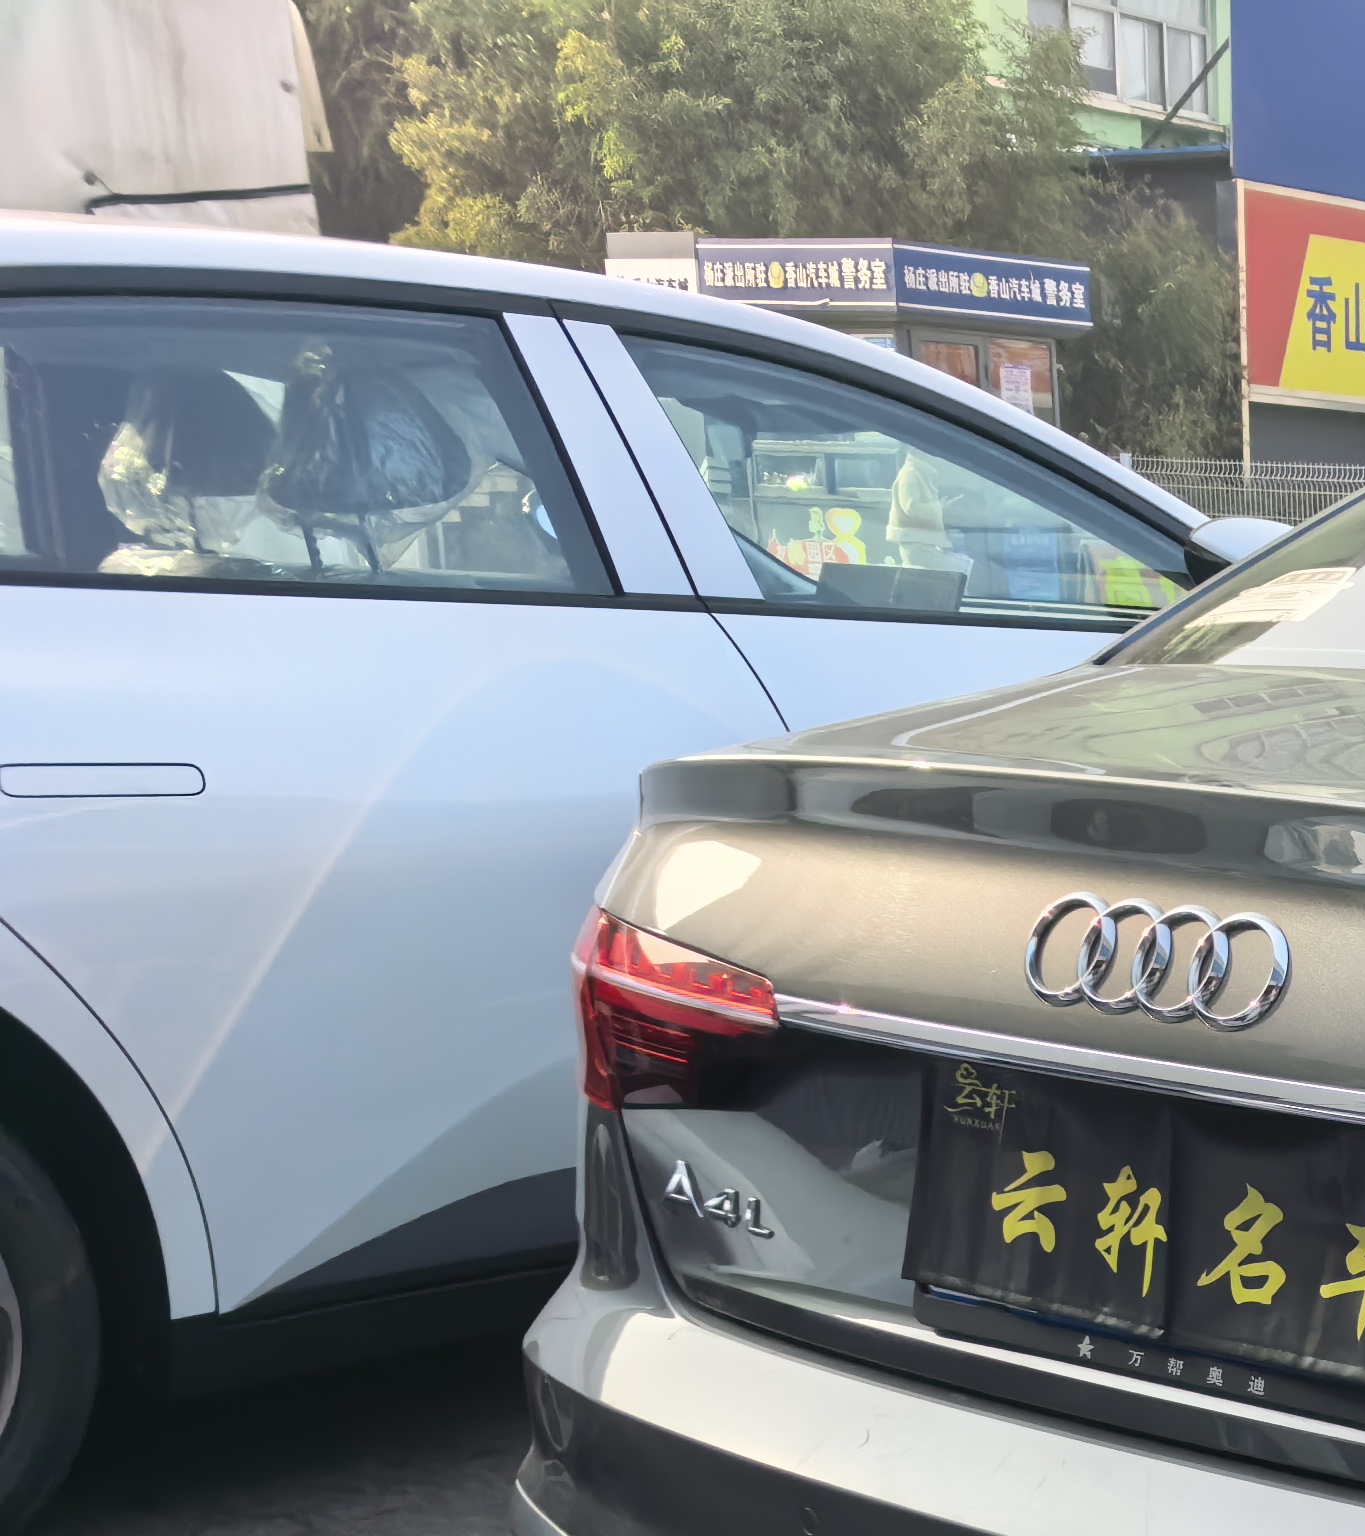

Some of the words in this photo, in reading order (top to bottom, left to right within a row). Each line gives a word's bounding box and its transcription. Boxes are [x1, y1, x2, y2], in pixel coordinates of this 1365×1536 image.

[663, 1159, 775, 1239] A4L
[1127, 1348, 1266, 1397] 万帮奥迪
